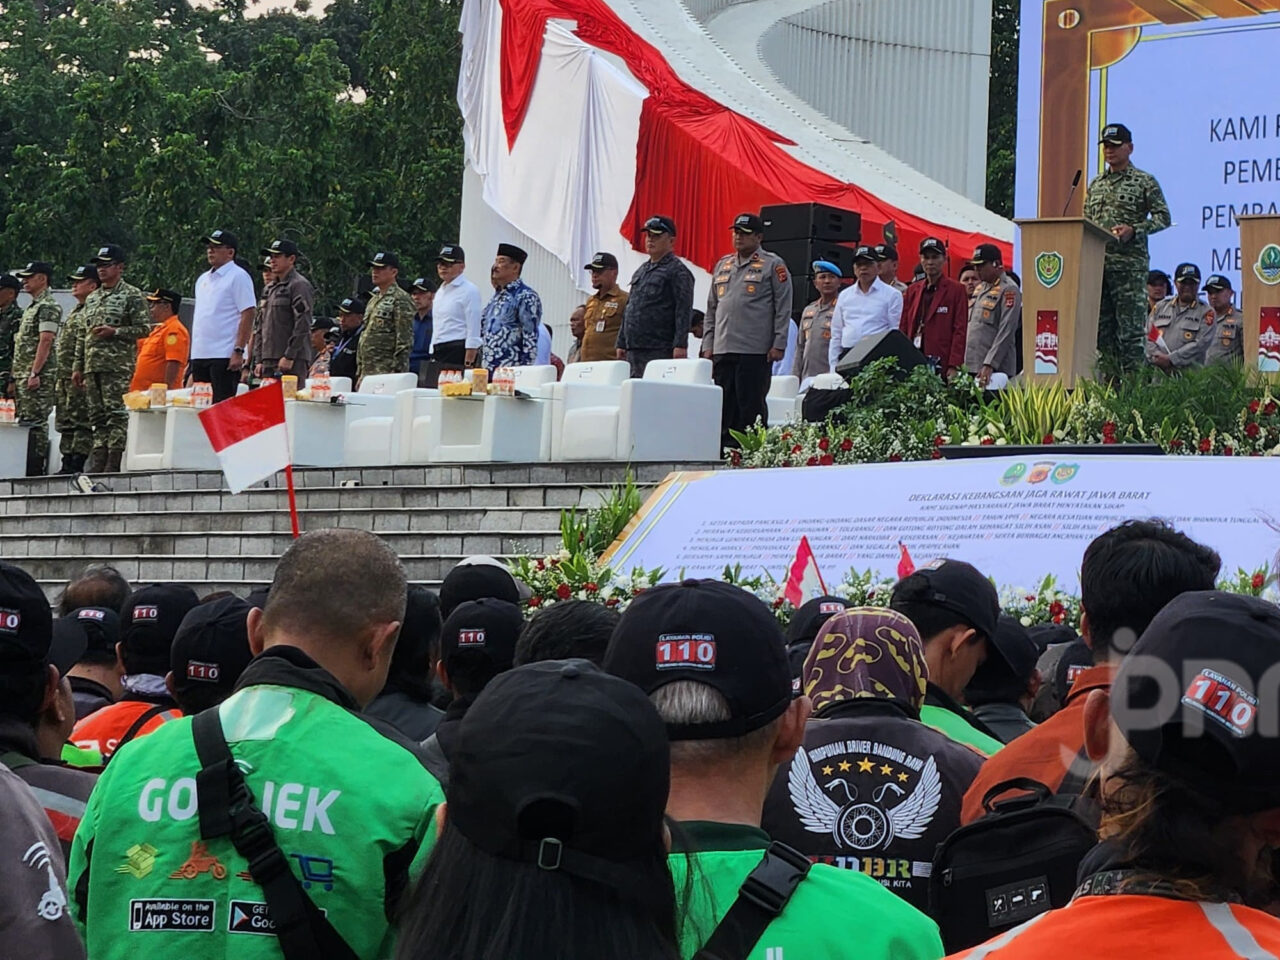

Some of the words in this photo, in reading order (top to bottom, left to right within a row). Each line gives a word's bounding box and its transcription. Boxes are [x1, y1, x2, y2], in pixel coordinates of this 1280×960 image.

[1210, 115, 1267, 143] KAMI
[908, 491, 961, 502] DEKLARASI
[960, 490, 1025, 501] KEBANGSAAN
[1023, 489, 1048, 500] JAGA
[1048, 489, 1087, 500] RAWAT
[1086, 489, 1117, 501] JAWA
[1117, 490, 1152, 501] BARAT
[133, 609, 158, 619] 110
[460, 631, 485, 643] 110
[660, 641, 713, 662] 110
[188, 664, 219, 679] 110
[1205, 671, 1236, 690] LAYANAN
[1235, 686, 1257, 705] POLISI
[1195, 680, 1252, 725] 110
[846, 740, 871, 754] DRIVER
[873, 742, 906, 764] BANDUNG
[893, 879, 912, 888] KITA
[181, 903, 193, 911] on
[195, 903, 209, 911] the
[145, 912, 168, 928] App
[171, 912, 209, 925] Store
